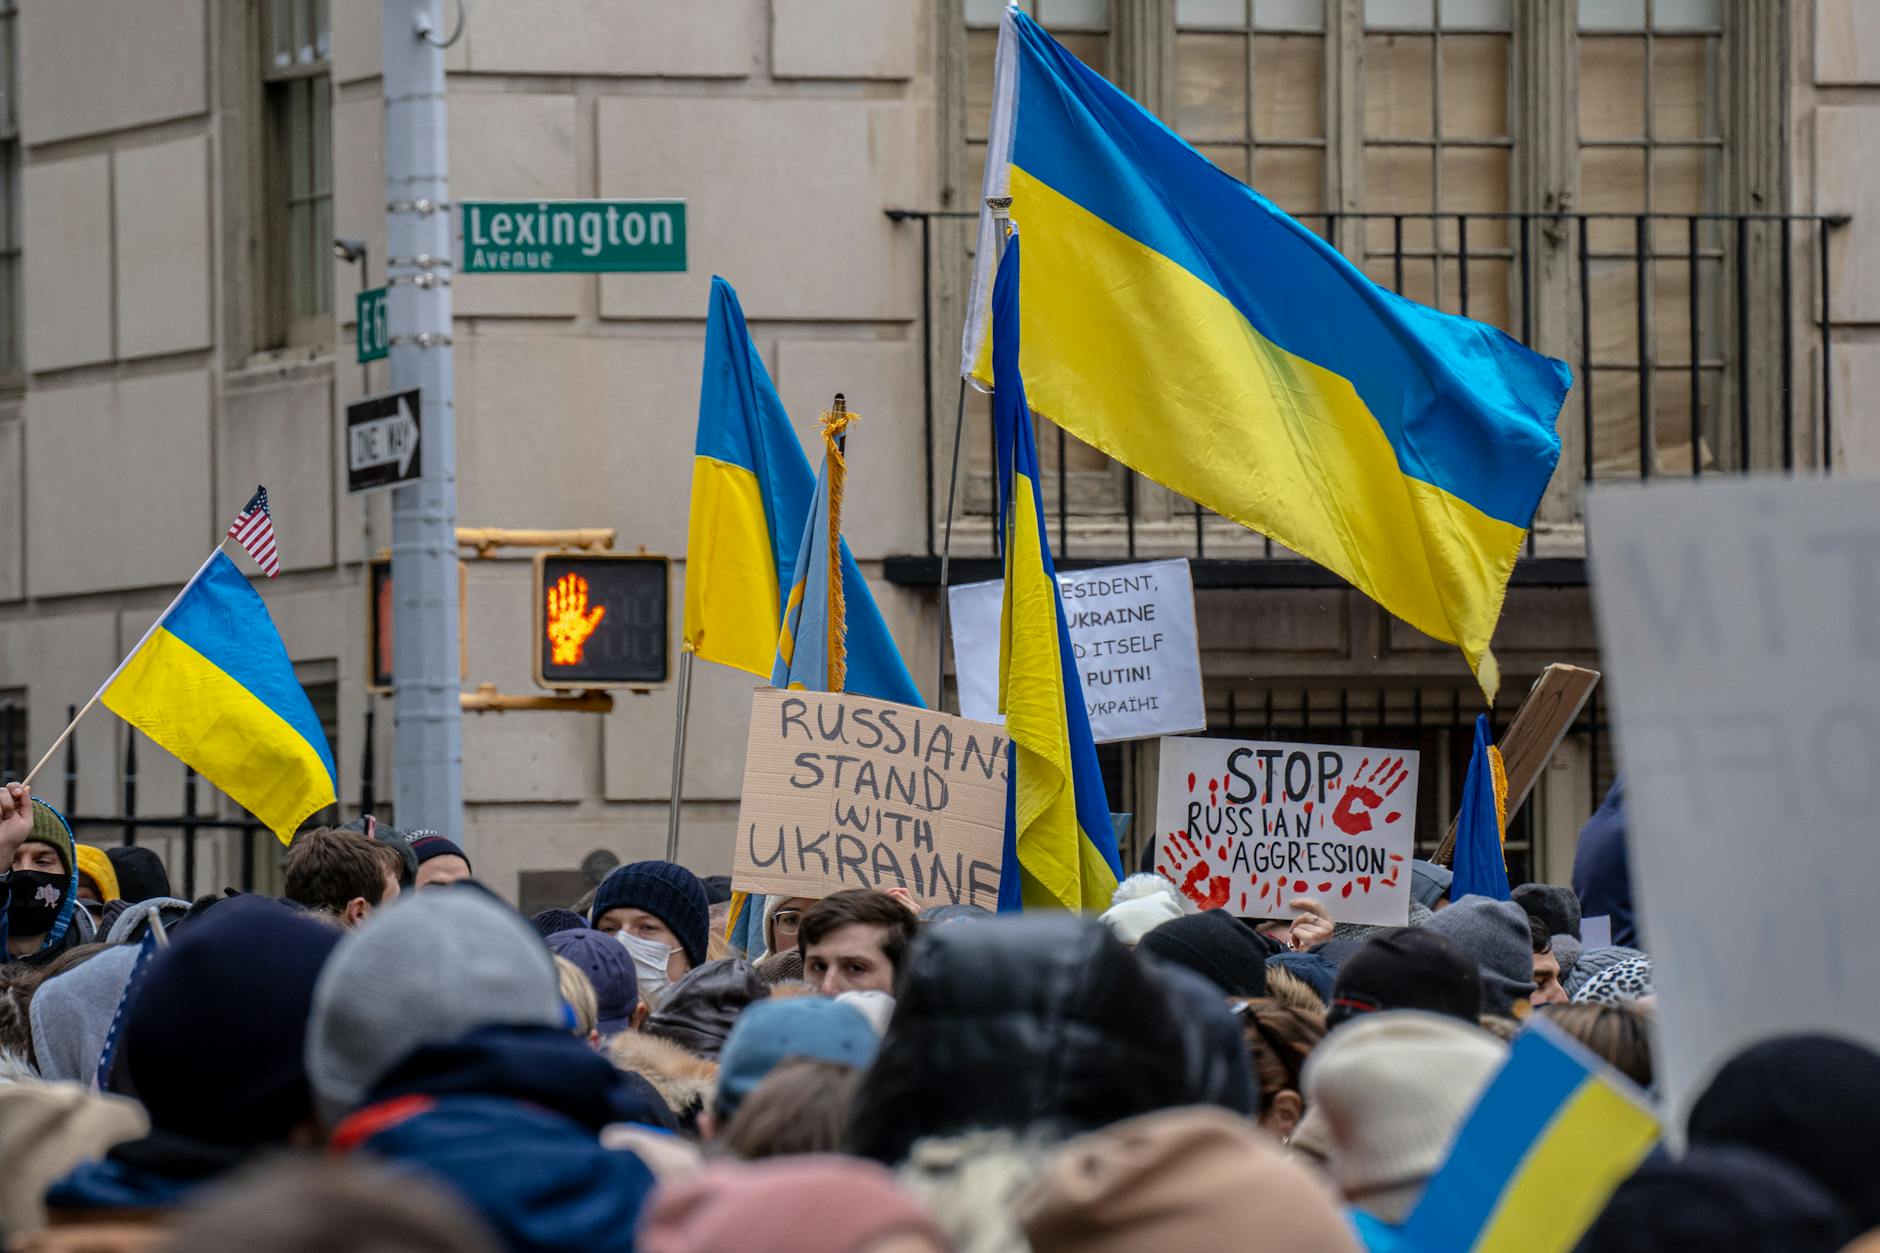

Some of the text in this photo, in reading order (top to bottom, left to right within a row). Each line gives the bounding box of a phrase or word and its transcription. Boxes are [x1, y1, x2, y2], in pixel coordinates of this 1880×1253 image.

[470, 204, 674, 256] Lexington
[473, 249, 553, 269] Avenue
[362, 301, 372, 353] E
[355, 419, 410, 463] ONE WAY
[1092, 633, 1164, 658] ITSELF
[1087, 666, 1152, 687] PUTIN!
[789, 752, 949, 812] STAND
[1225, 747, 1343, 804] STOP
[835, 798, 934, 854] WITH
[1187, 801, 1311, 841] RUSSIAN
[749, 822, 1001, 906] UKRAINE
[1231, 841, 1386, 874] AGGRESSION
